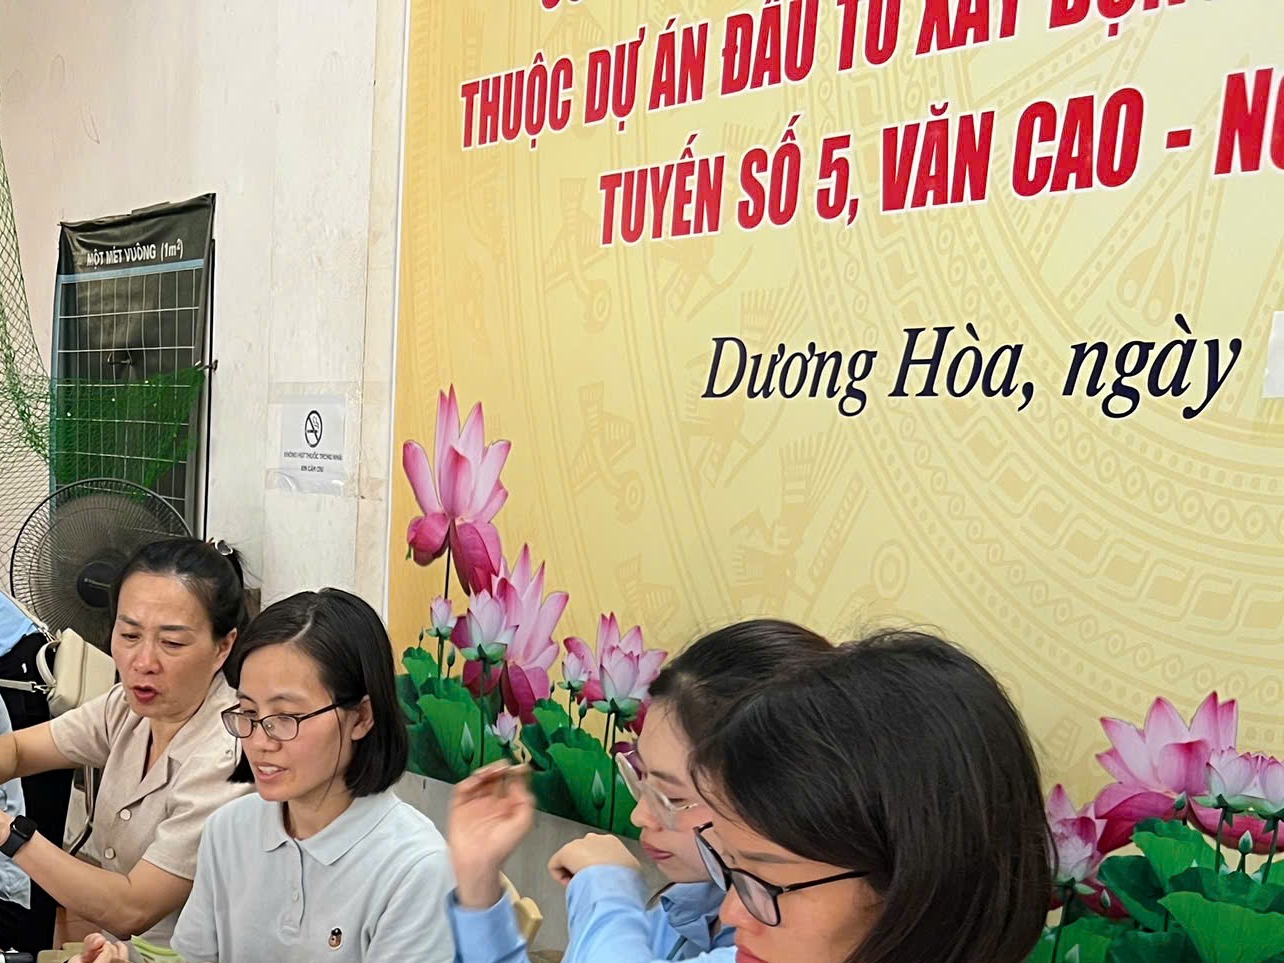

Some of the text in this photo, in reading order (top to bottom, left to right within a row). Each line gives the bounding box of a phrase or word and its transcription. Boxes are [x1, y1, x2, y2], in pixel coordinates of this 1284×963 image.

[461, 52, 573, 148] THUỘC
[584, 27, 645, 131] DỰ
[648, 18, 709, 110] ÁN
[600, 133, 725, 245] TUYẾN
[737, 114, 802, 229] SỐ
[816, 134, 859, 226] 5,
[882, 101, 995, 212] VĂN
[1012, 87, 1144, 197] CAO
[87, 248, 104, 269] MỘT
[124, 242, 157, 262] VUÔNG
[700, 313, 1243, 420] Dương Hòa, ngày
